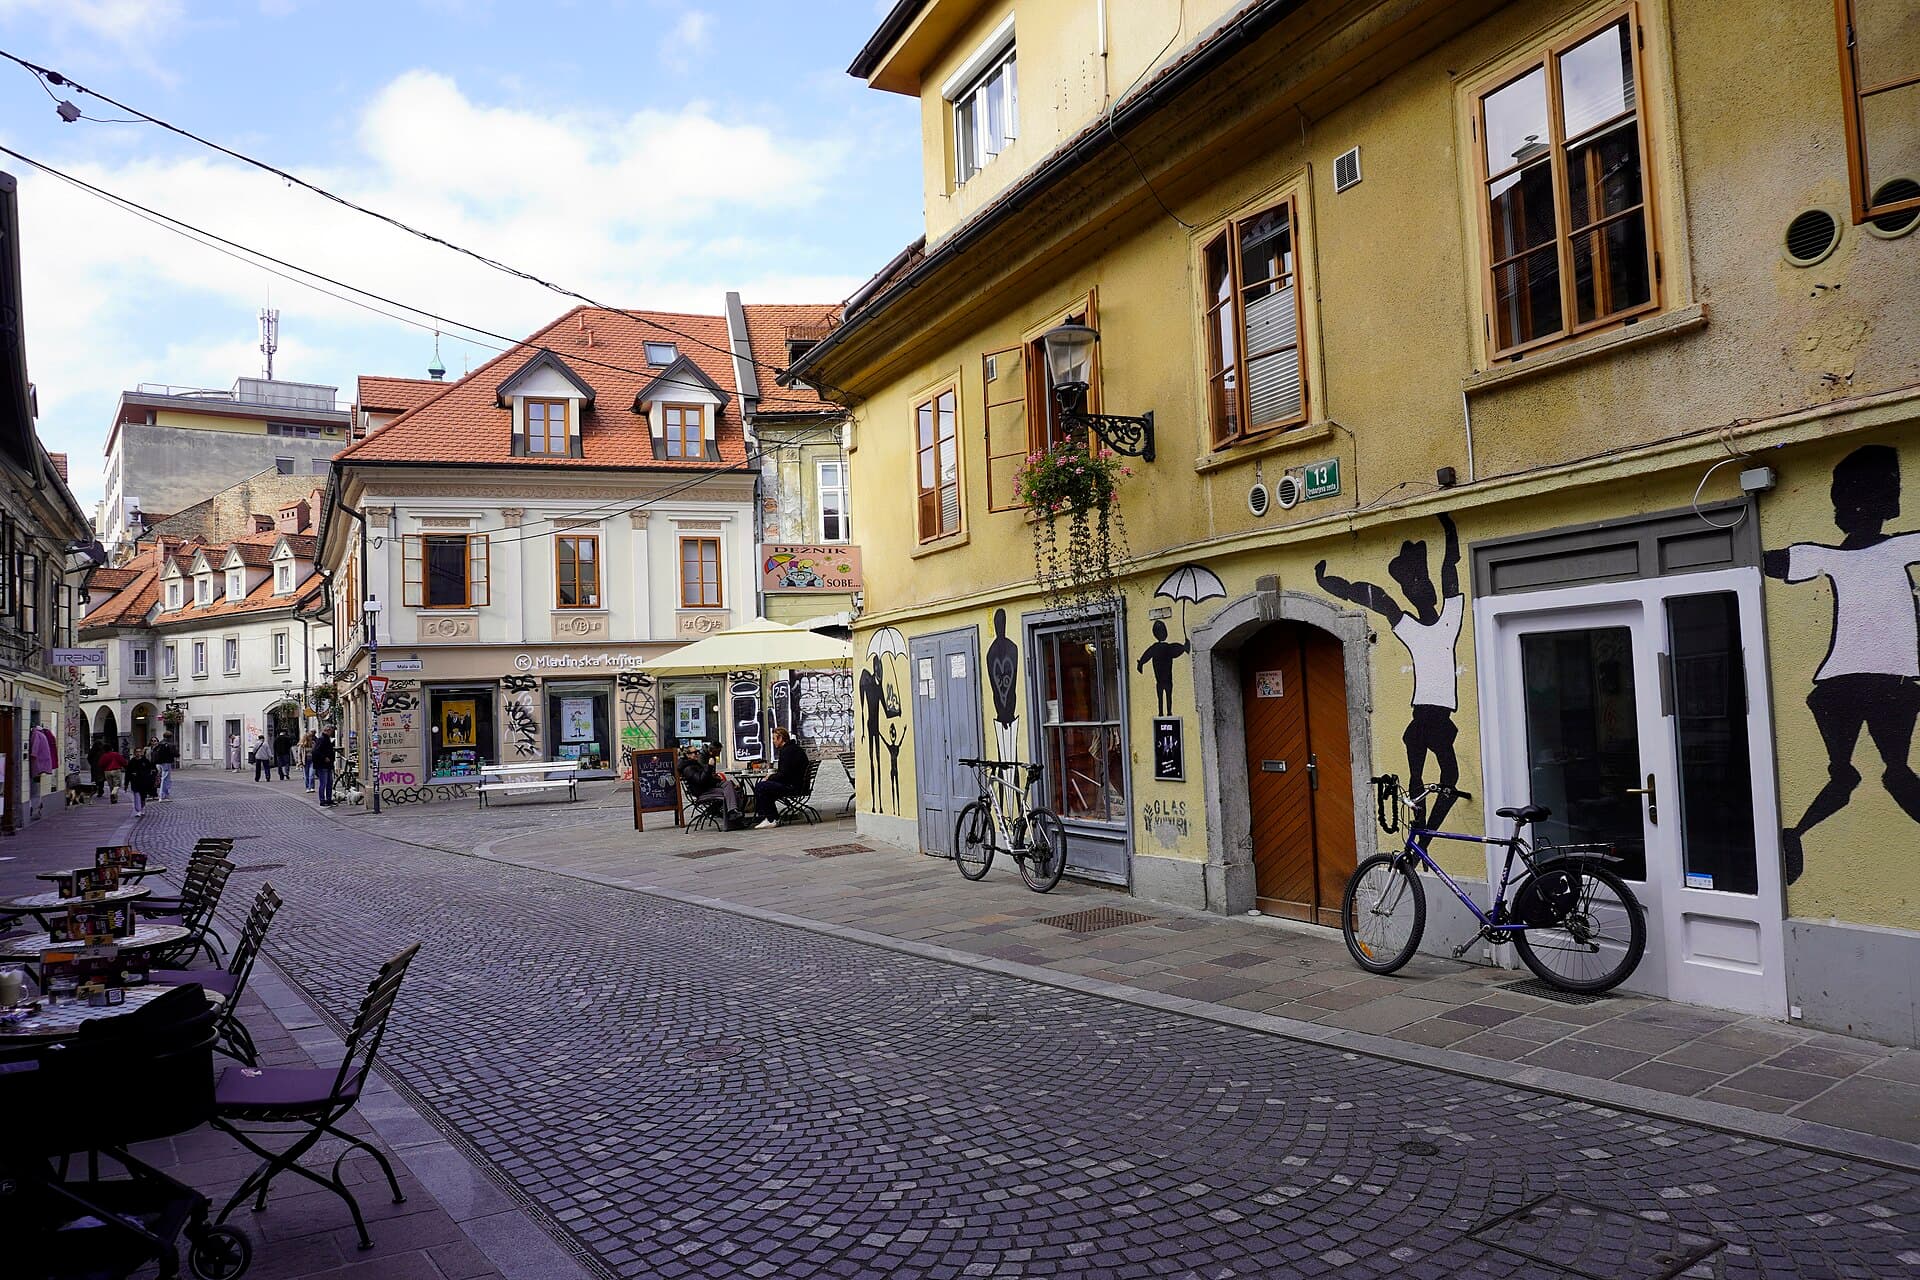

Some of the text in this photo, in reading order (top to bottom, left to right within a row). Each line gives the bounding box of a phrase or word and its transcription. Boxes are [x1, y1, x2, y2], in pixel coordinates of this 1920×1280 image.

[1314, 467, 1327, 486] 13
[774, 546, 848, 554] DEŽNIK
[536, 653, 643, 668] Mladinska knjiga
[1154, 800, 1186, 816] GLAS
